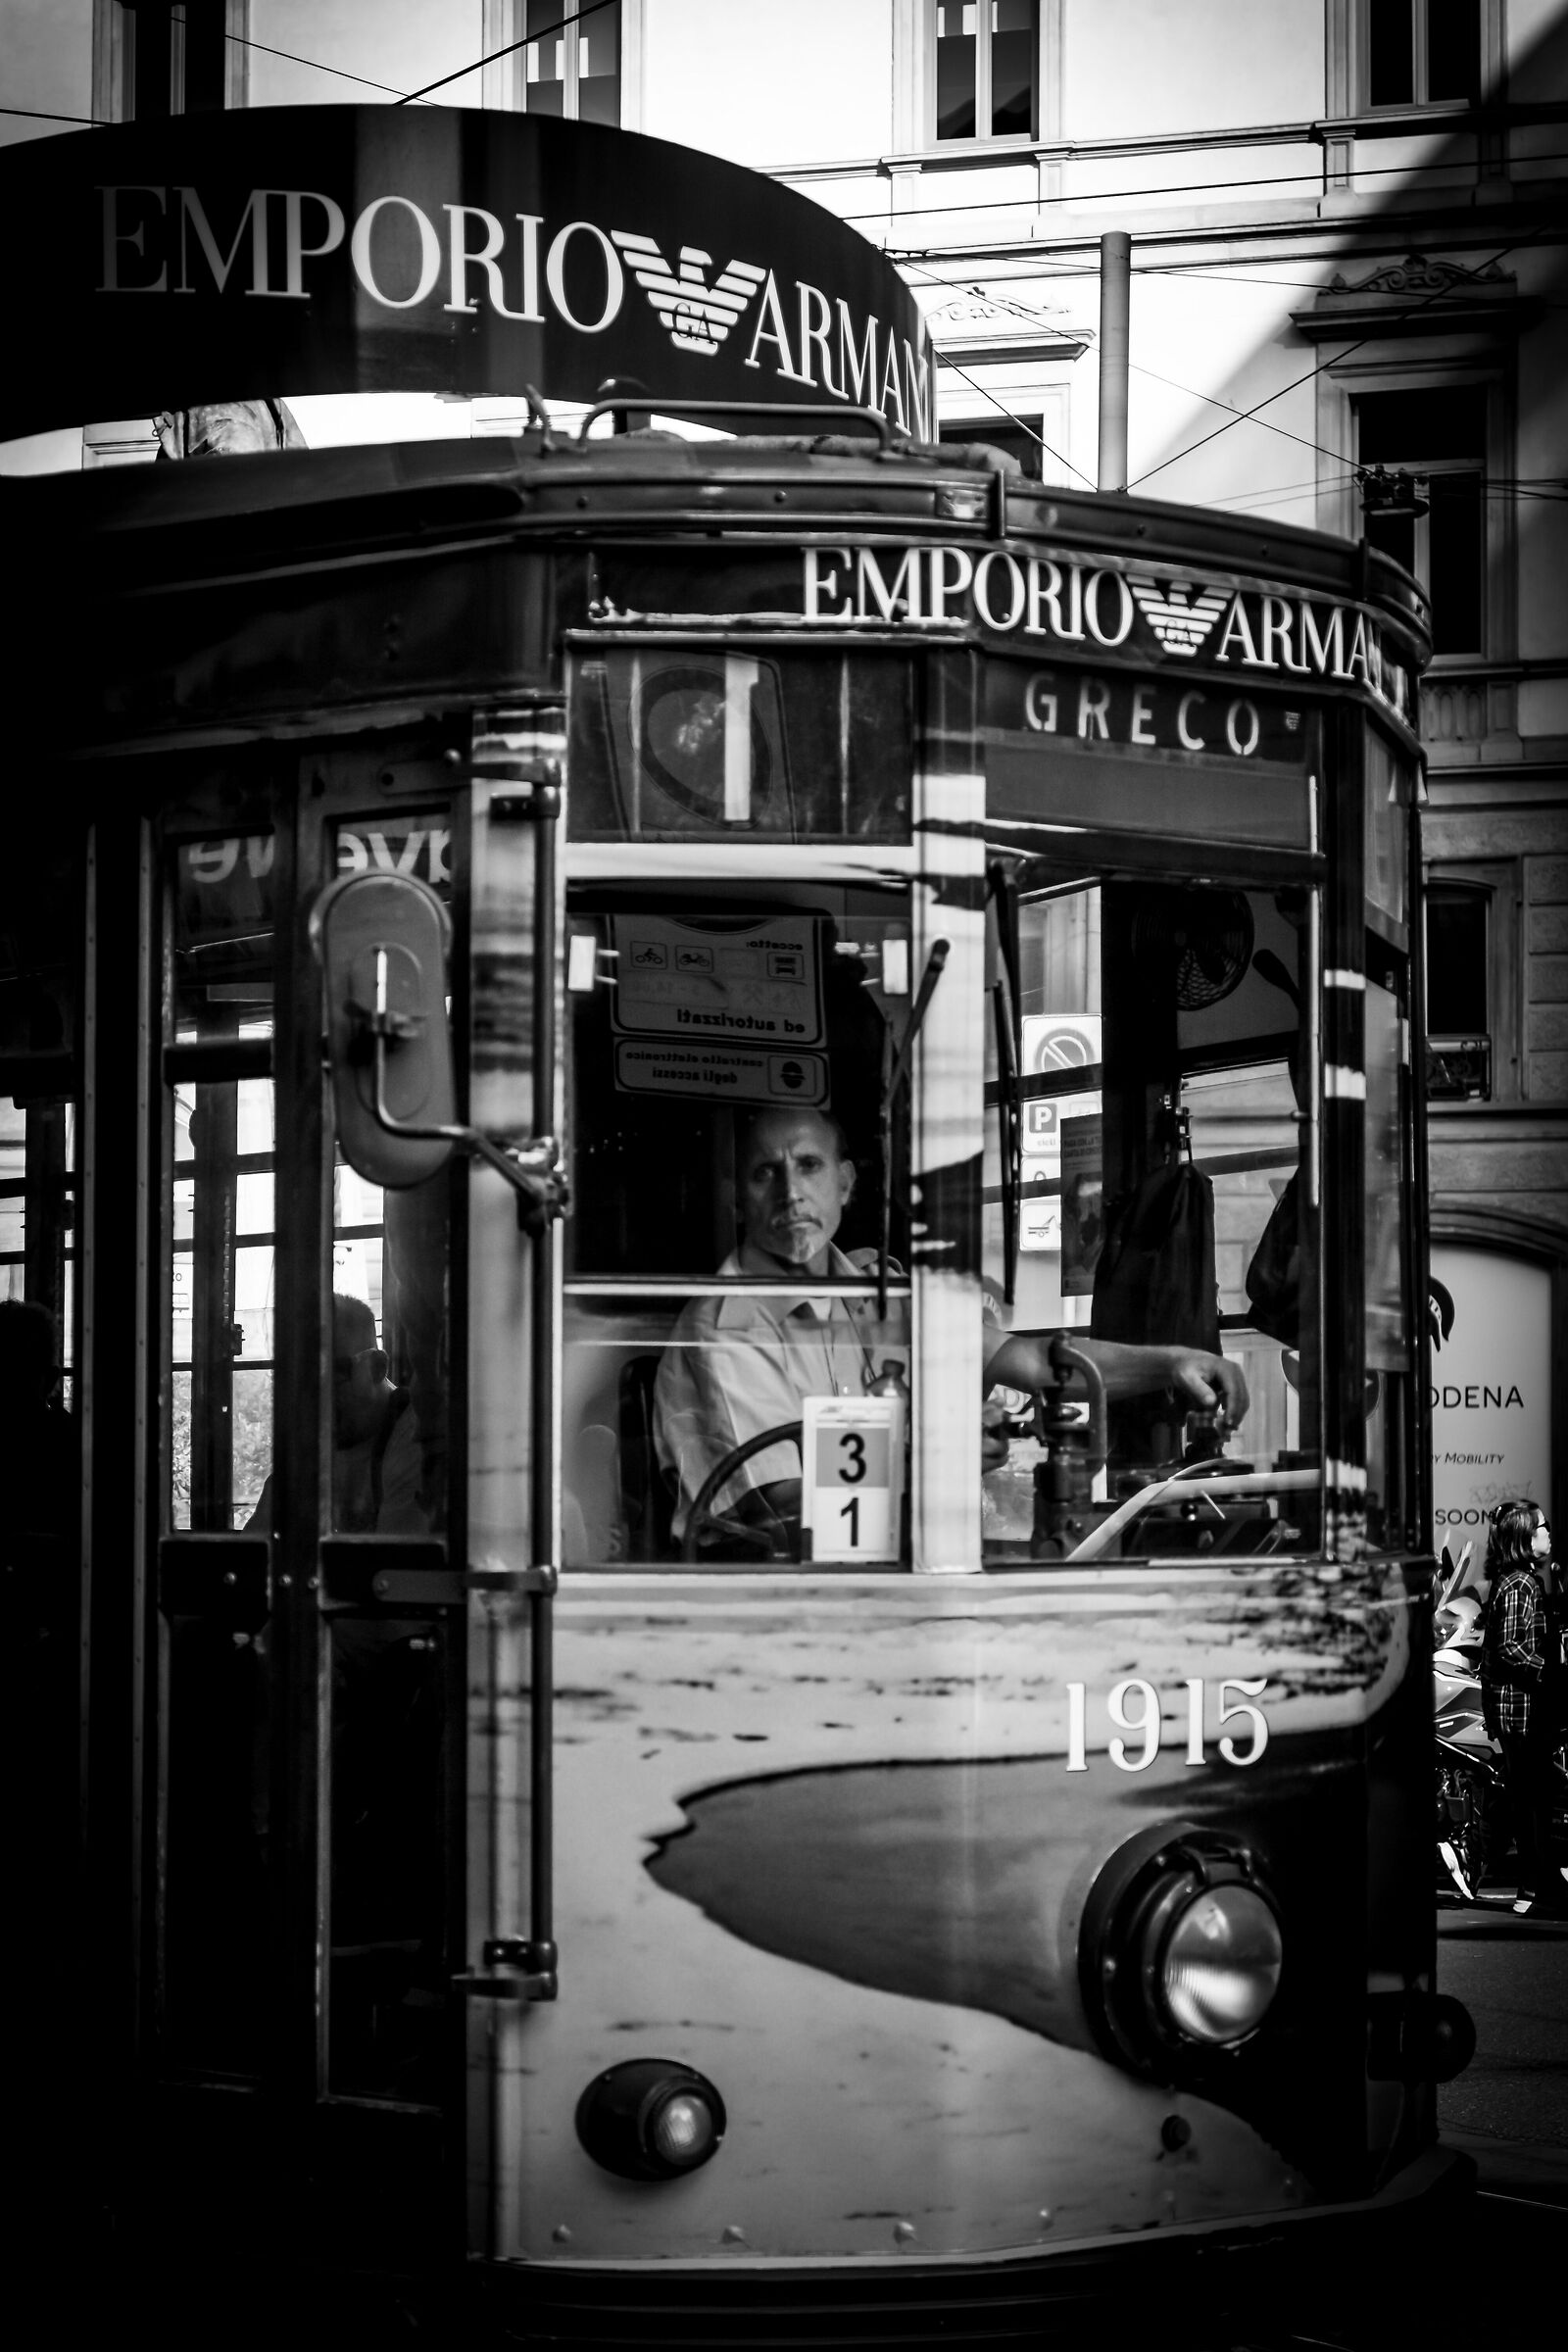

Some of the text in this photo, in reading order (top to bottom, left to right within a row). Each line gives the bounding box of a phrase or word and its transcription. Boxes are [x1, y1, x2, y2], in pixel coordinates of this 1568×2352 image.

[93, 184, 625, 333] EMPORIO
[803, 545, 1136, 647] EMPORIO
[1214, 590, 1388, 706] ARMA
[1024, 670, 1260, 756] GRECO
[1035, 1106, 1053, 1131] P
[838, 1432, 867, 1485] 3
[840, 1496, 859, 1548] 1
[1065, 1677, 1269, 1772] 1915
